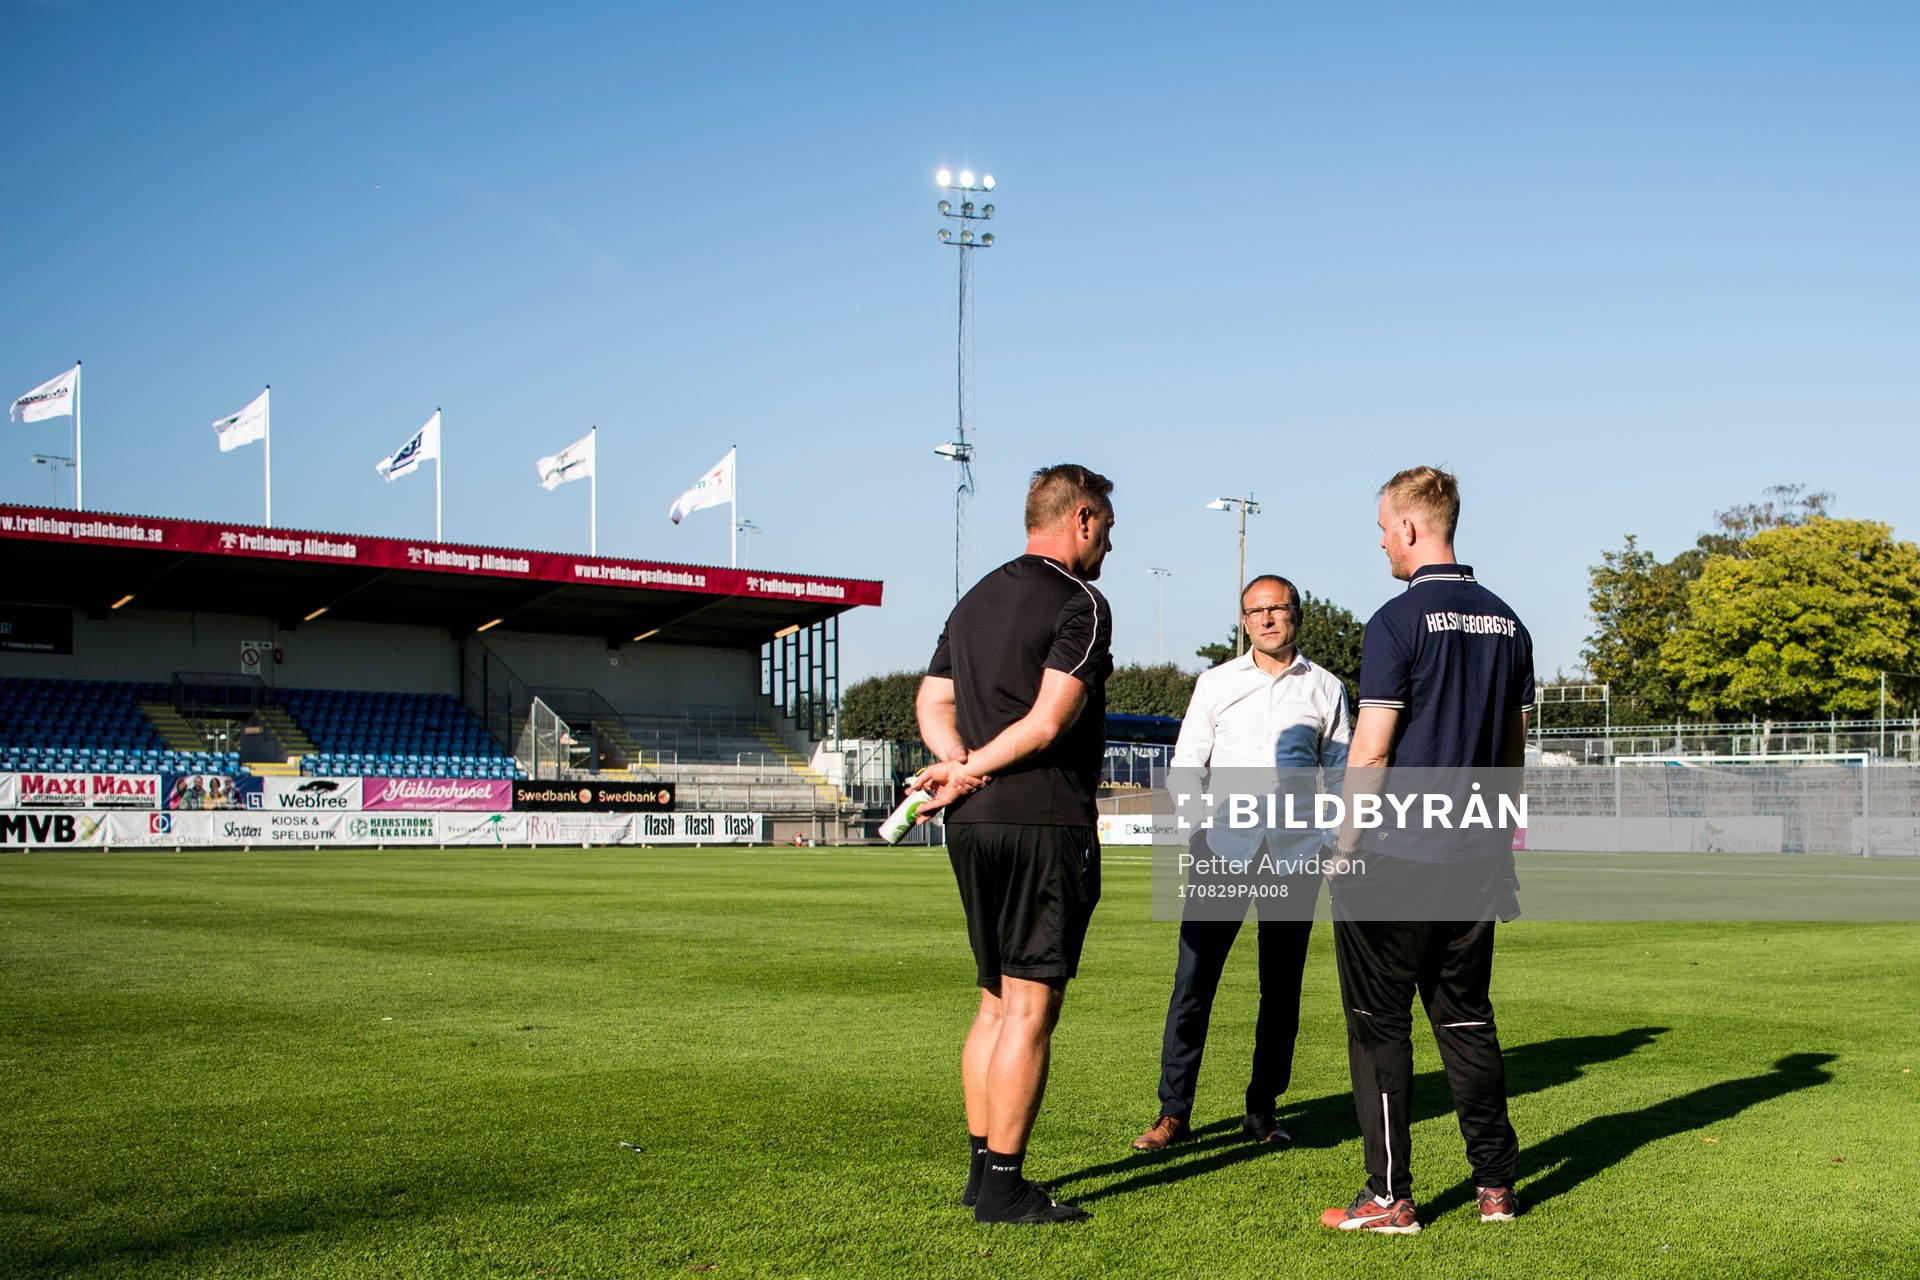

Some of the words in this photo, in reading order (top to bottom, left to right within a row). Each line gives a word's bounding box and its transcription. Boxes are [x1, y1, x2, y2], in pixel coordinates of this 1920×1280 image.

[0, 515, 163, 543] w.trelleborgsallehanda.se
[239, 533, 302, 556] Trelleborgs
[303, 538, 357, 559] Allehanda
[424, 548, 481, 570] Trelleborgs
[481, 554, 530, 573] Allehanda
[575, 564, 706, 588] www.trelleborgsallehanda.se
[759, 578, 806, 597] Trelleborgs
[806, 582, 845, 599] Allehanda
[383, 779, 493, 801] Mäklarhuset
[517, 789, 577, 802] Swedbank
[598, 790, 656, 803] Swedbank
[0, 814, 76, 843] MVB
[223, 822, 262, 841] Skytten
[272, 816, 308, 826] KIOSK
[311, 816, 320, 826] &
[370, 817, 433, 827] HERRSTRÖMS
[644, 814, 675, 836] flash
[685, 814, 715, 836] flash
[724, 814, 754, 836] flash
[272, 830, 336, 840] SPELBUTIK
[370, 828, 433, 837] MEKANISKA
